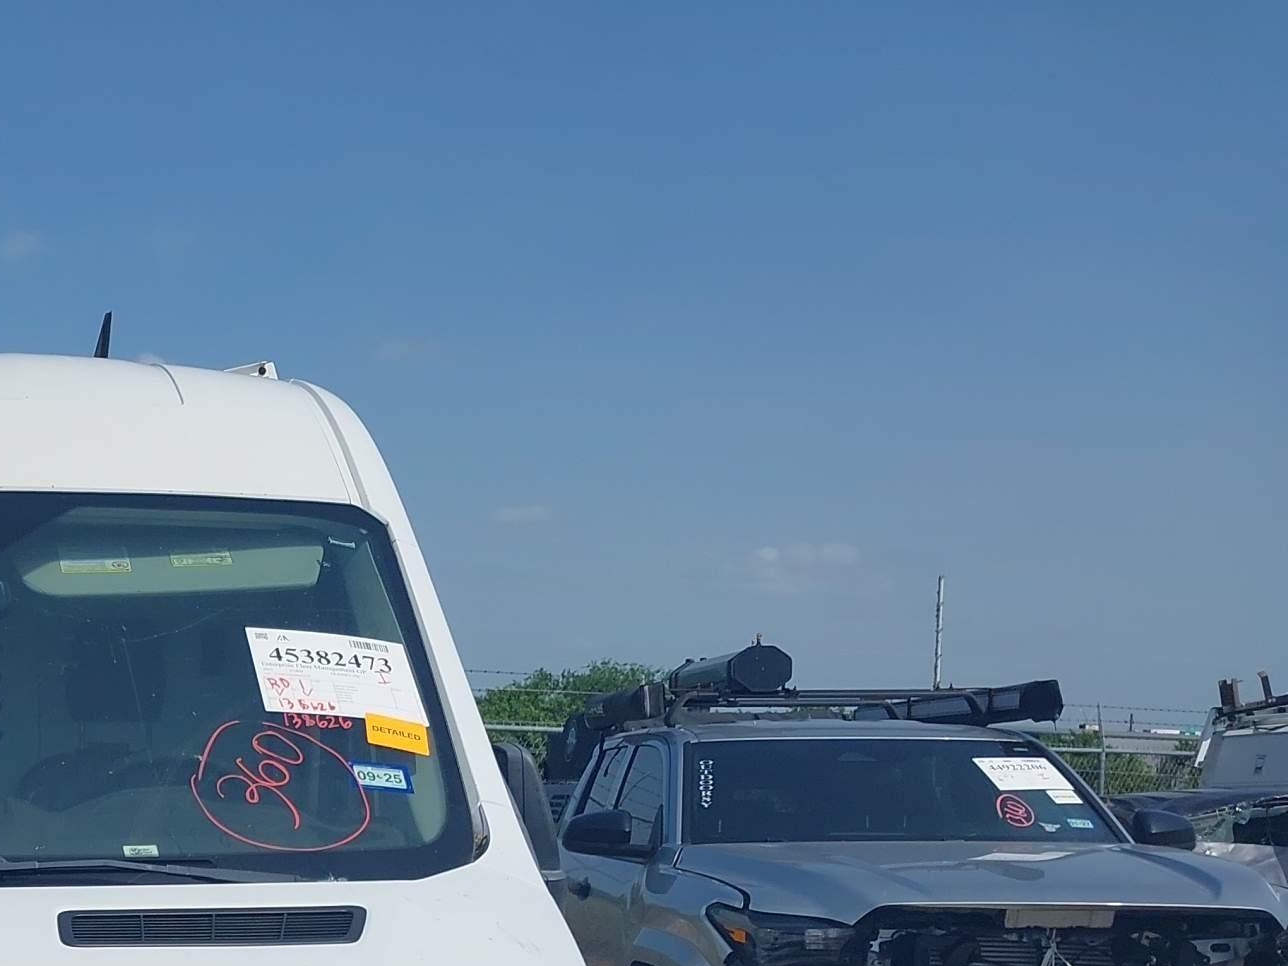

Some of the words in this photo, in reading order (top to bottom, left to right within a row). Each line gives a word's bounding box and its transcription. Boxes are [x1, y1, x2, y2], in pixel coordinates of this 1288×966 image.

[269, 647, 392, 673] 45382473
[372, 725, 421, 741] DETAILED
[357, 770, 376, 781] 09
[383, 773, 402, 784] 25
